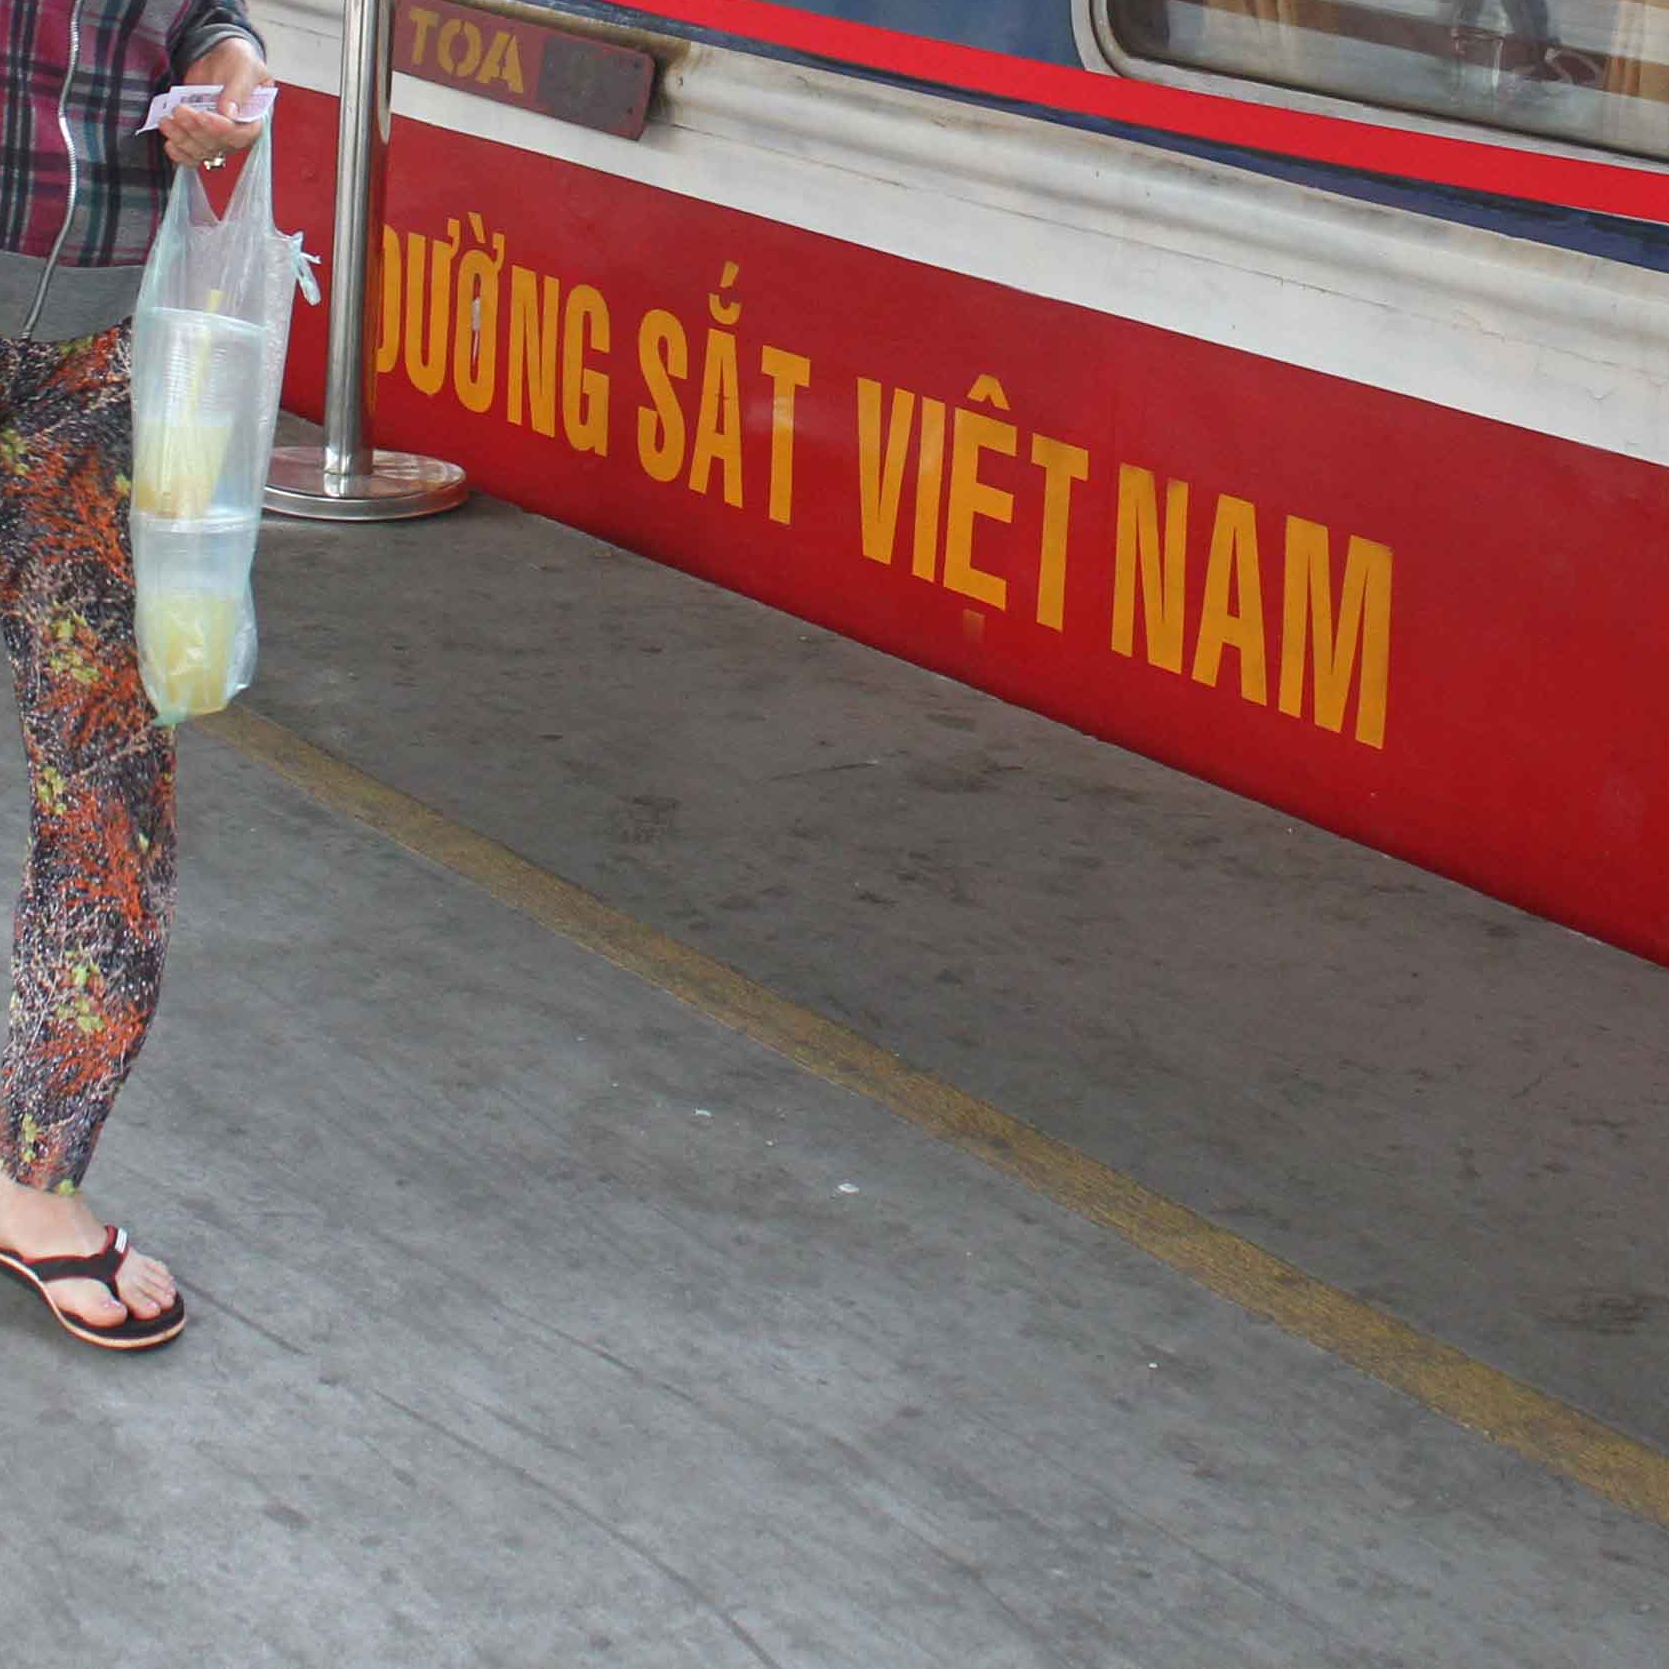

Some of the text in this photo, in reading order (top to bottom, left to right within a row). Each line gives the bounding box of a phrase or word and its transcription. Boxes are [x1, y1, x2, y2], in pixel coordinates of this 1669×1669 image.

[409, 6, 524, 94] TOA
[637, 260, 812, 525] SẮT
[1111, 462, 1394, 750] NAM
